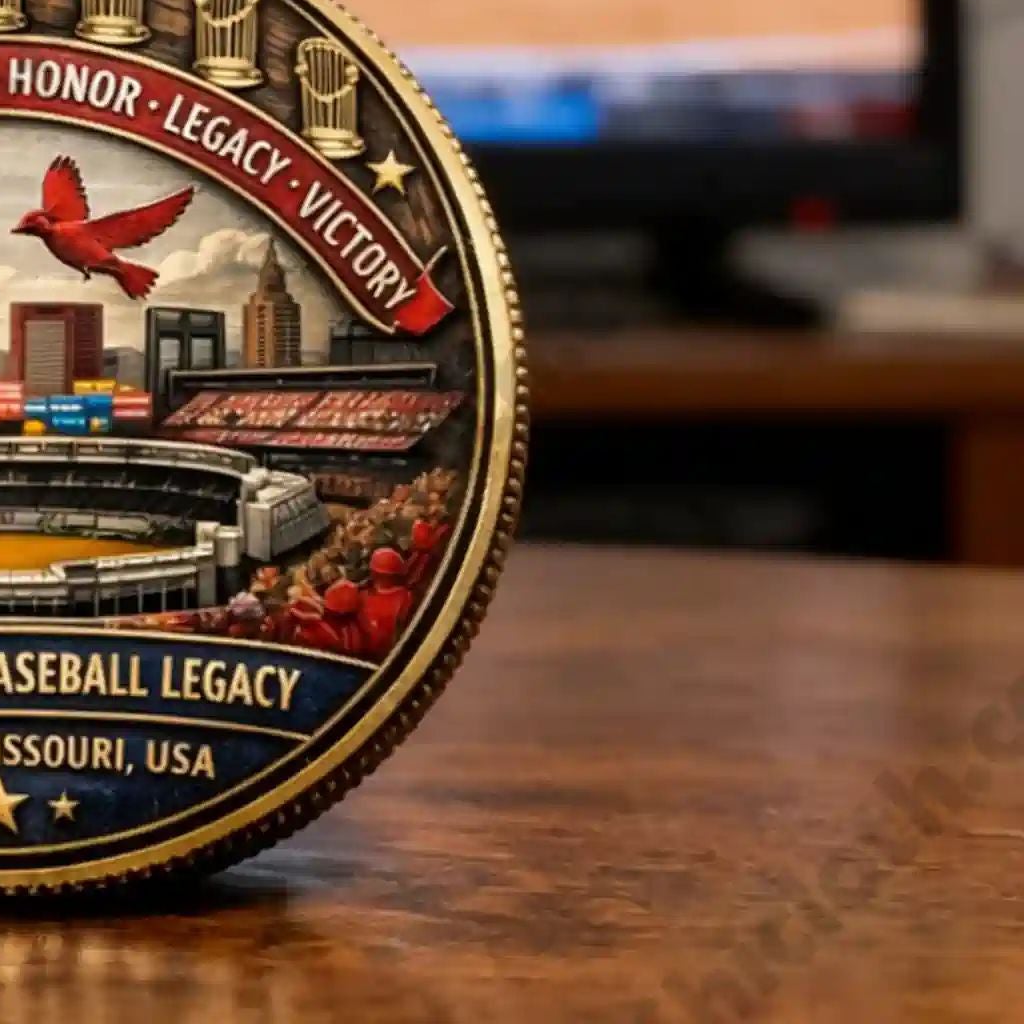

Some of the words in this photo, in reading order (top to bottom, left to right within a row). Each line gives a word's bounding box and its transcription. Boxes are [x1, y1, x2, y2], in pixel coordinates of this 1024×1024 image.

[8, 57, 143, 118] HONOR
[163, 94, 293, 186] LEGACY
[296, 179, 419, 310] VICTORY
[160, 657, 304, 711] LEGACY
[145, 740, 216, 779] USA
